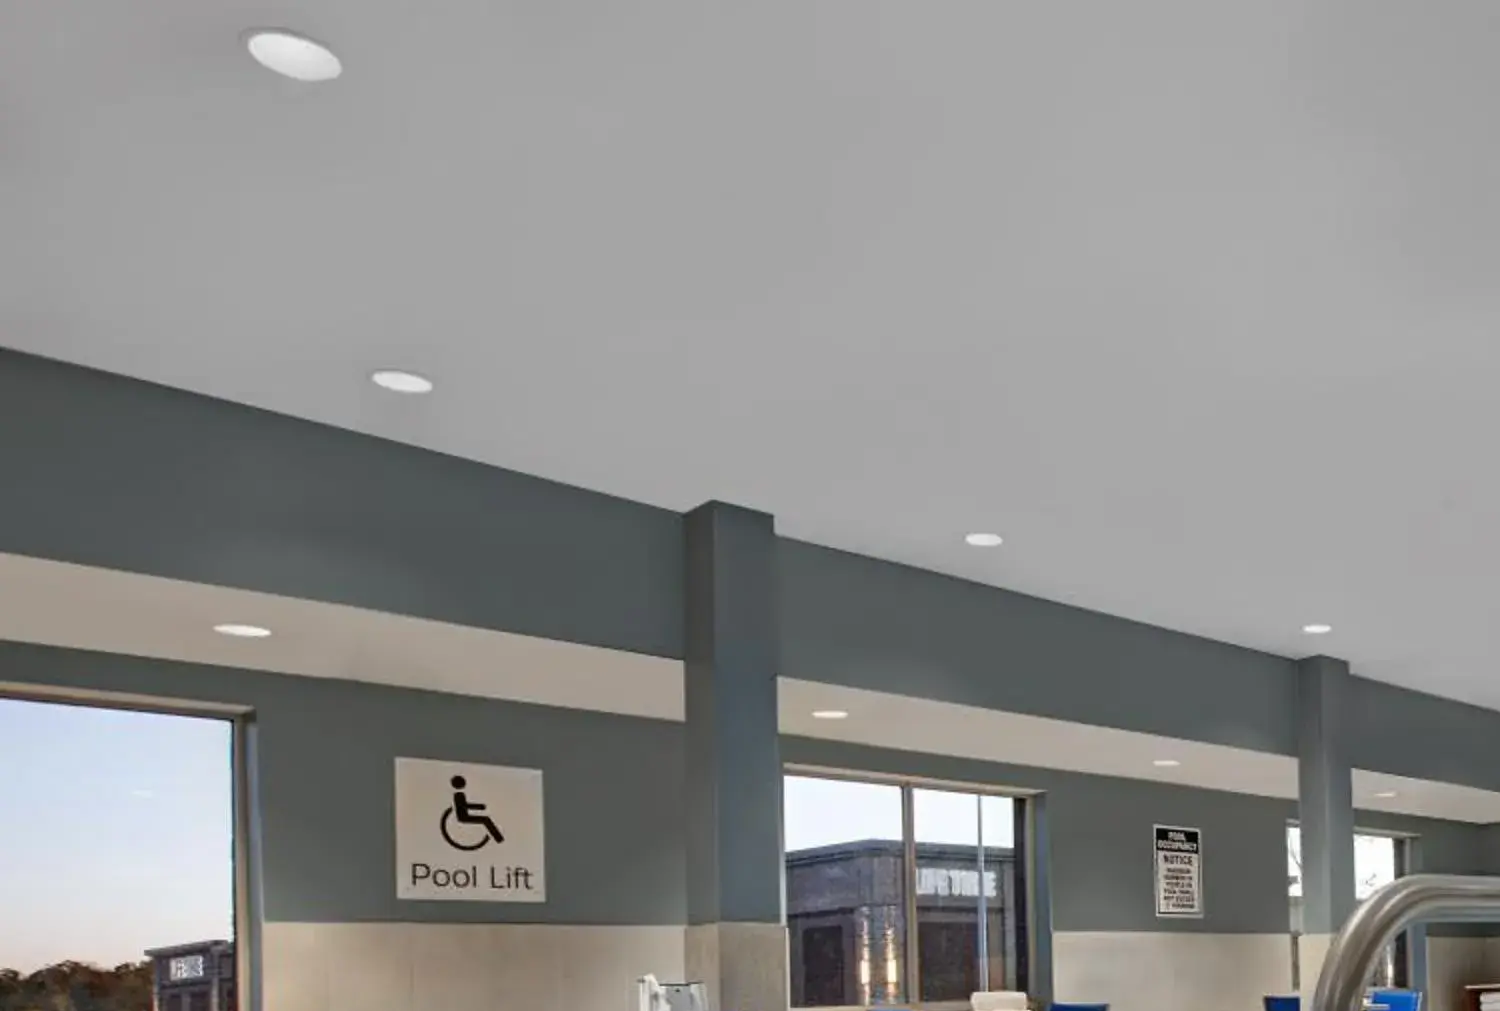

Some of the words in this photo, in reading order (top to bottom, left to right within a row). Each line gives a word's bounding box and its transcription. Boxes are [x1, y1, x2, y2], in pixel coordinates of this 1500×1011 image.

[1163, 854, 1193, 866] NOTICE
[411, 863, 477, 888] Pool
[490, 866, 534, 890] Lift
